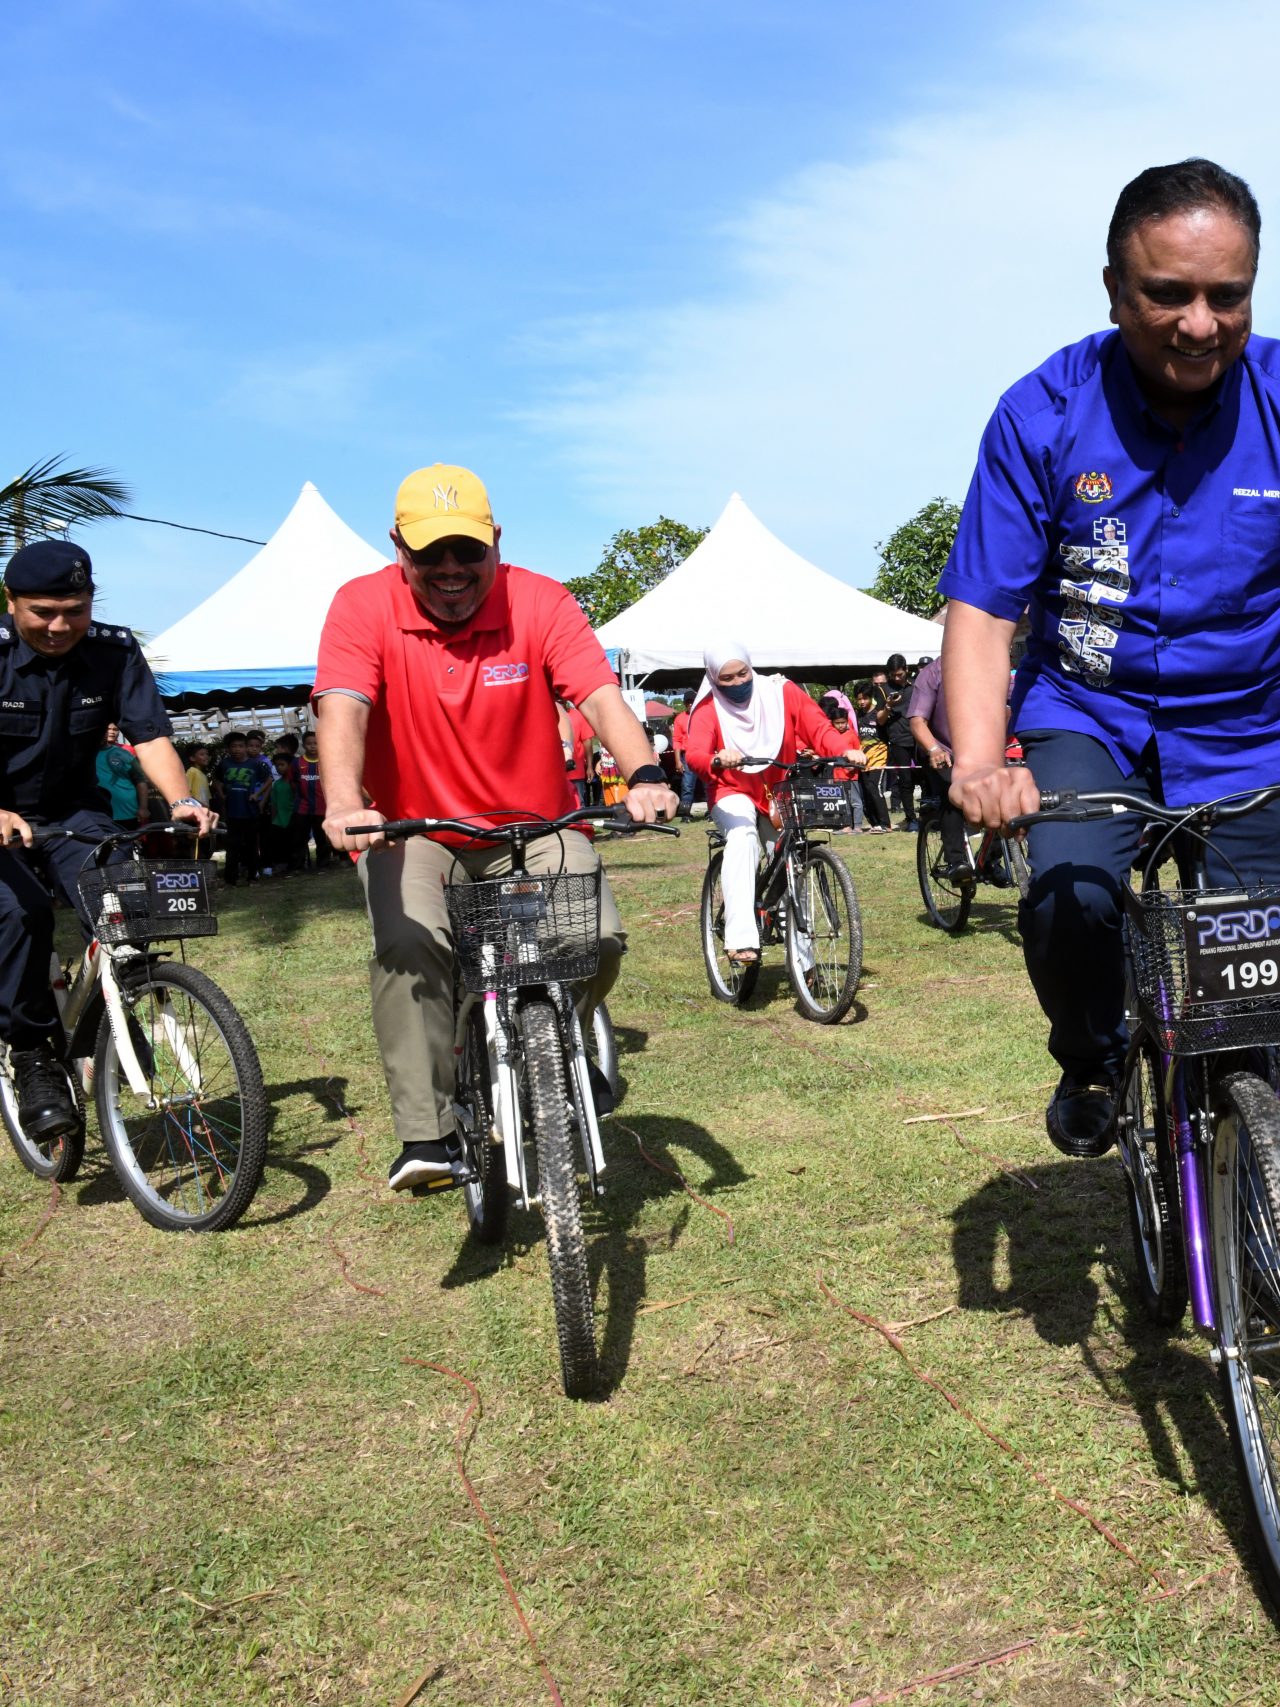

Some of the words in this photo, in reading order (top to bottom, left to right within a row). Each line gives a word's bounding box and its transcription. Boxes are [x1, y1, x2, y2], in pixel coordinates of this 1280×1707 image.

[1233, 488, 1261, 497] REEZAL
[81, 695, 103, 706] POLIS
[823, 802, 840, 811] 201
[155, 872, 200, 889] PERDA
[167, 897, 197, 912] 205
[1199, 946, 1217, 956] PENANG
[1216, 944, 1237, 954] REGIONAL
[1237, 940, 1266, 951] DEVELOPMENT
[1220, 958, 1279, 991] 199
